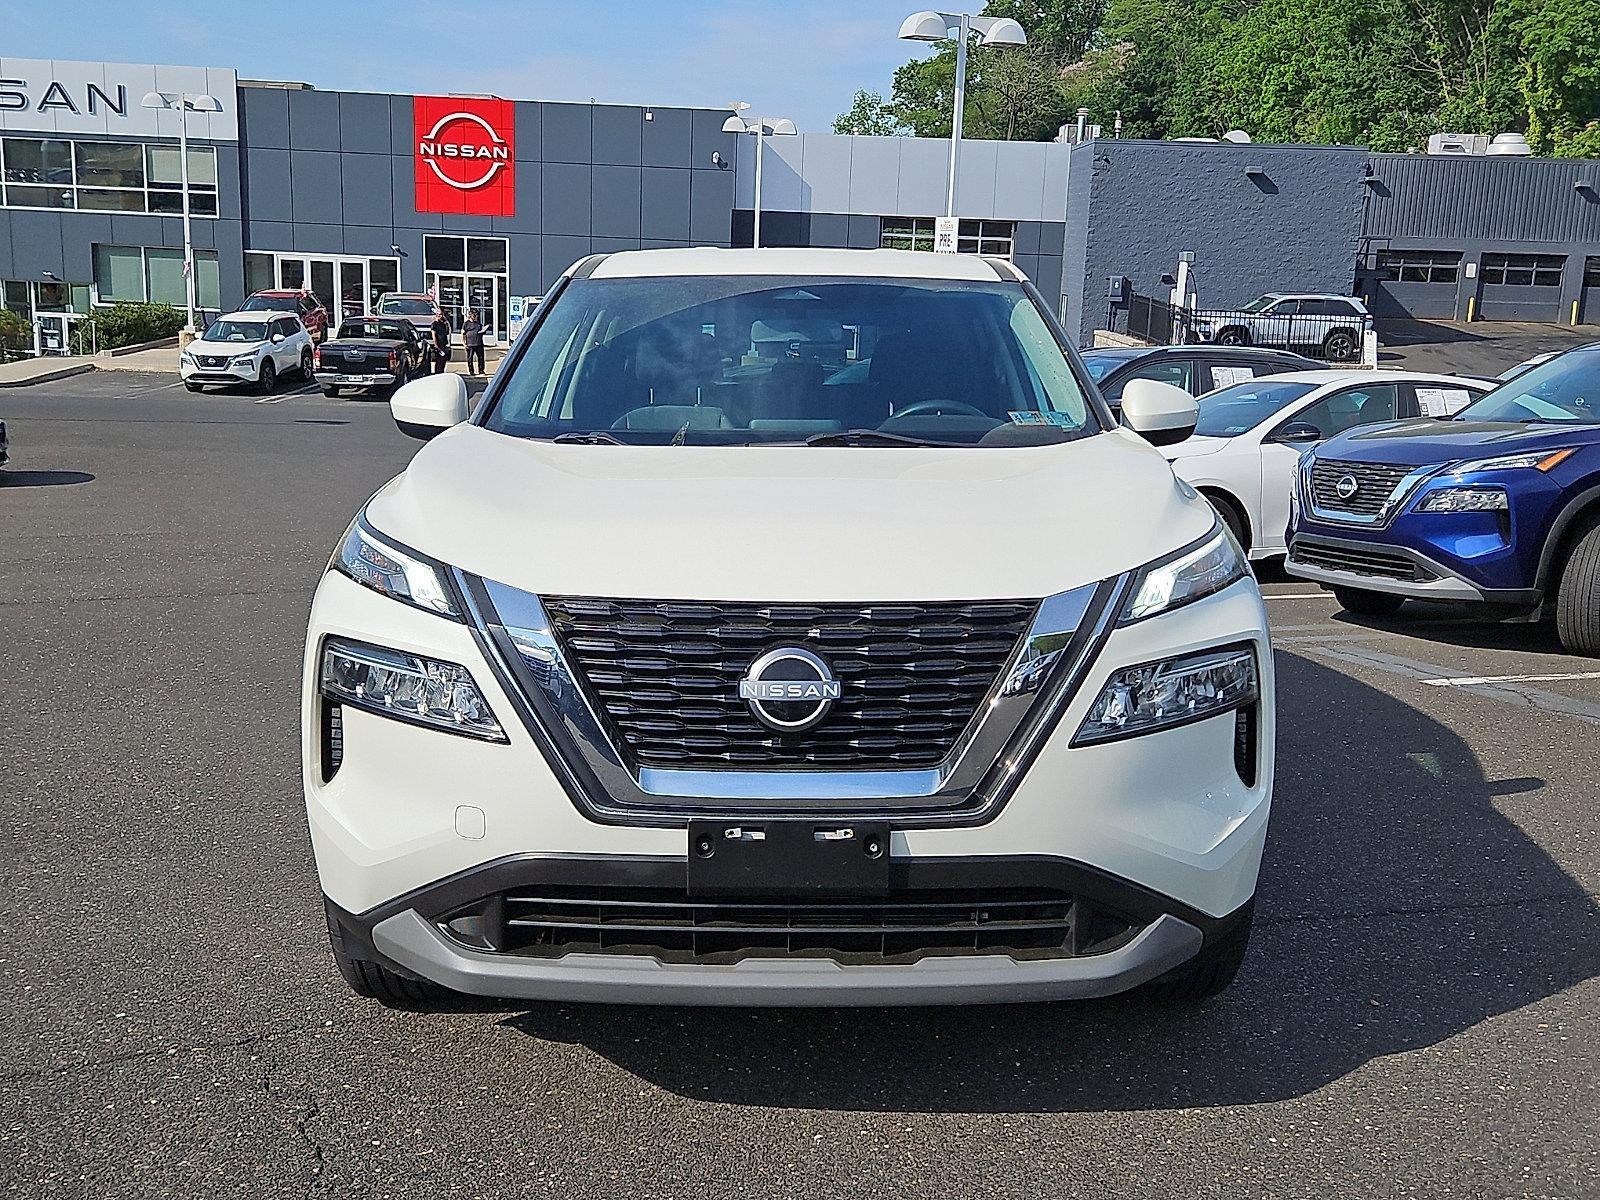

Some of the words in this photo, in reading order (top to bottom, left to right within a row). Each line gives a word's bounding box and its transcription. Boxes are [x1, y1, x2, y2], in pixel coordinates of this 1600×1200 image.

[0, 78, 127, 117] SAN
[420, 142, 508, 159] NISSAN
[939, 233, 953, 247] PRE-
[742, 683, 839, 698] NISSAN
